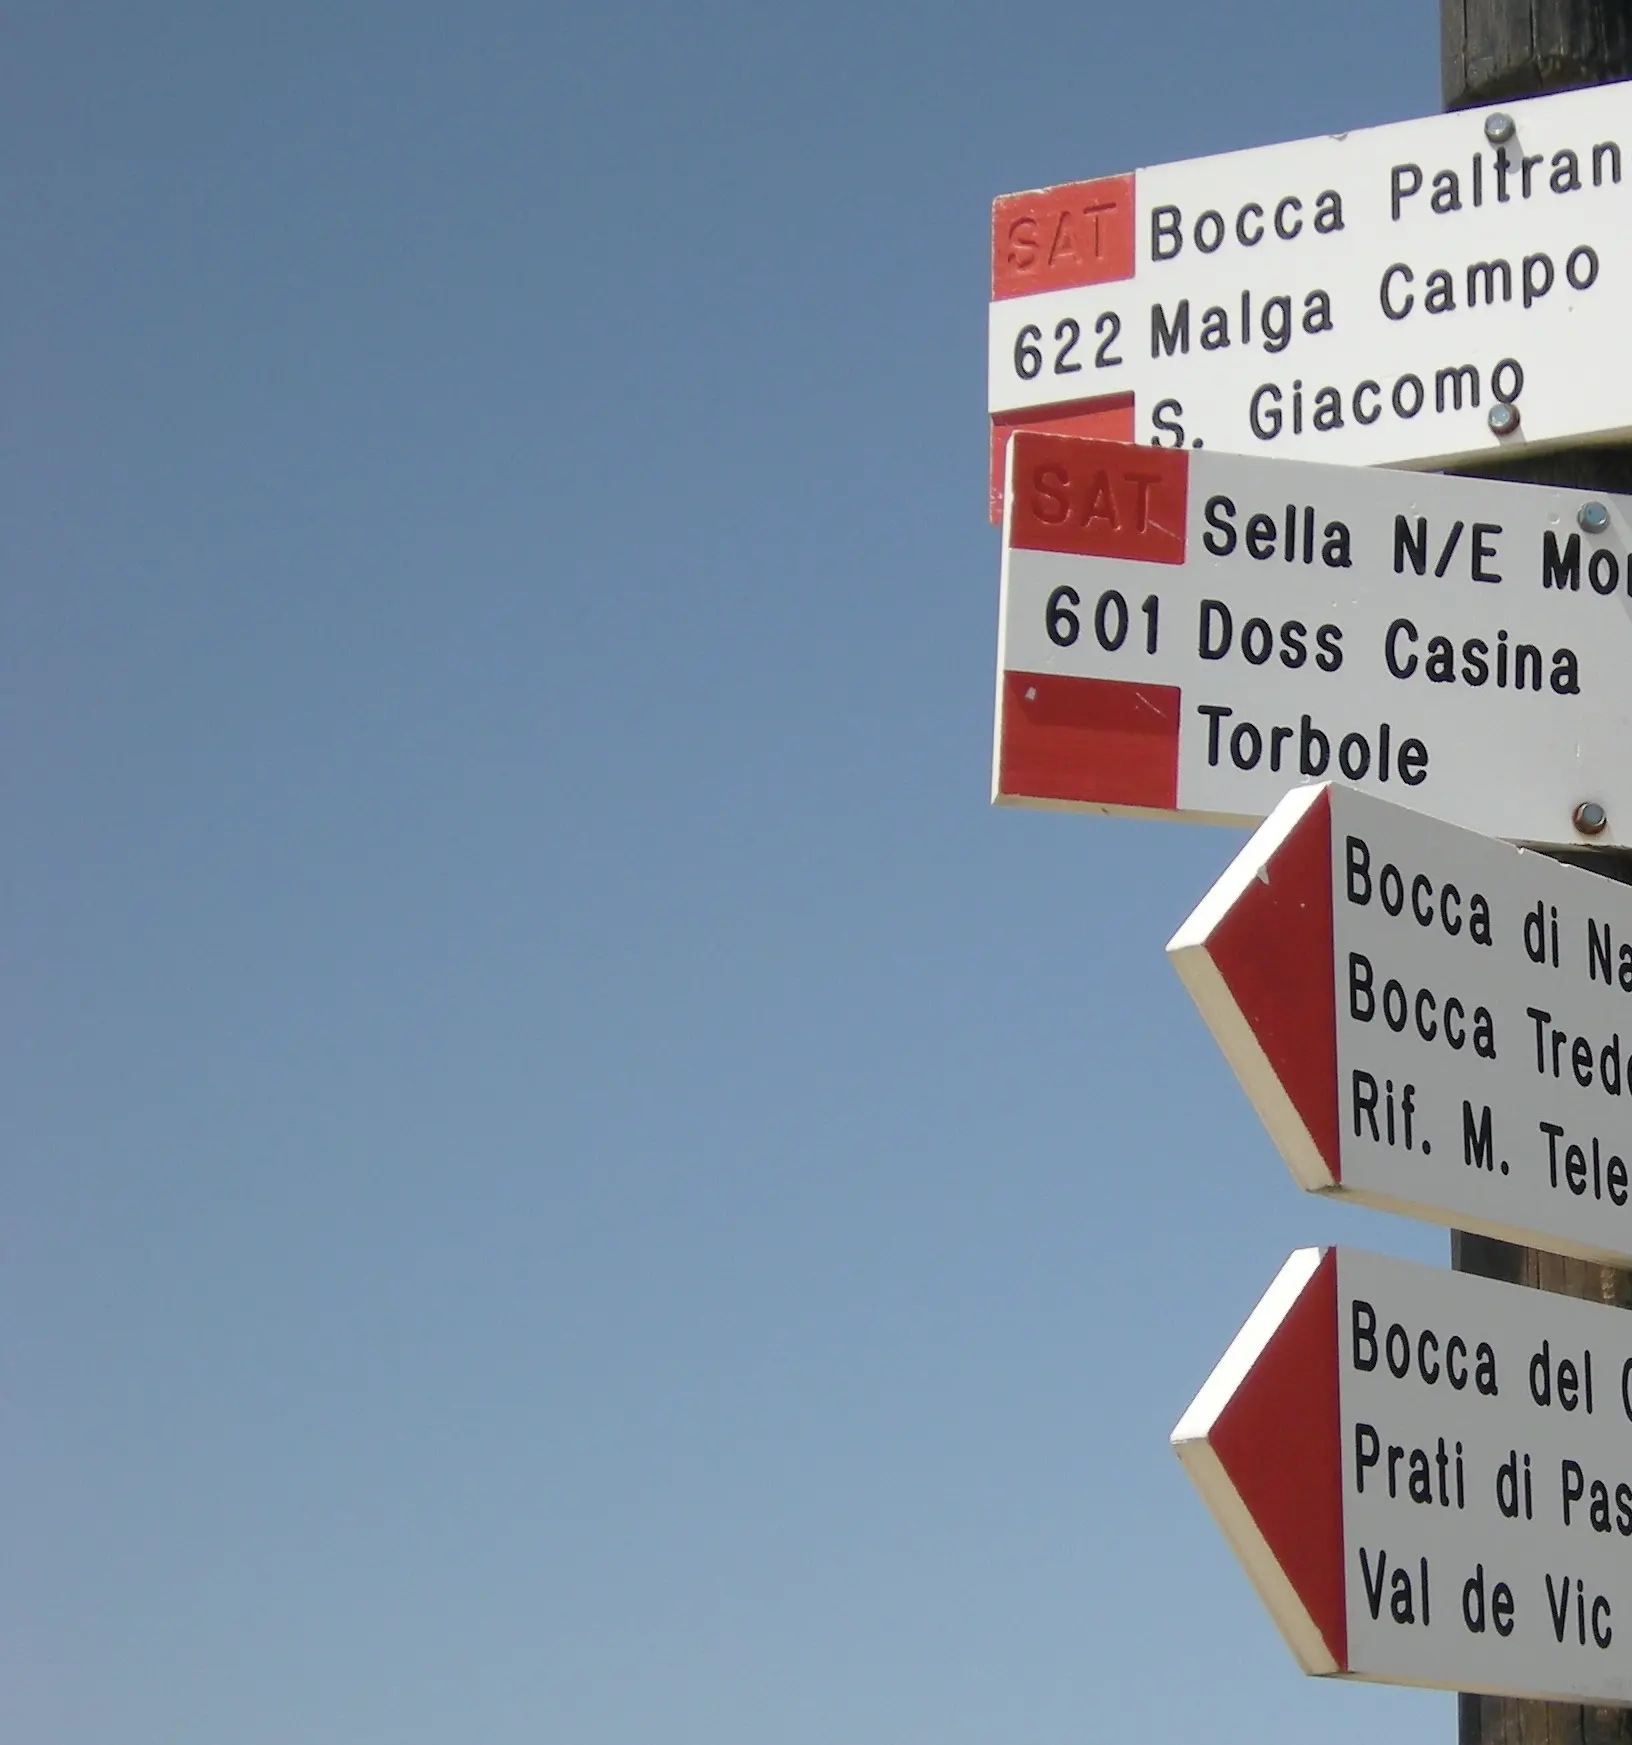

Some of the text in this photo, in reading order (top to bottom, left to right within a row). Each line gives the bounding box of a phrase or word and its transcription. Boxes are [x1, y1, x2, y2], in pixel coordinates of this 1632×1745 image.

[1007, 202, 1117, 271] SAT
[1151, 192, 1344, 262] Bocca
[1014, 312, 1122, 379] 622
[1151, 291, 1333, 358] Malga
[1380, 247, 1599, 320] Campo
[1152, 399, 1203, 448] S.
[1250, 359, 1524, 440] Giacomo
[1031, 461, 1163, 534] SAT
[1202, 495, 1353, 569] Sella
[1393, 514, 1503, 584] N/E
[1045, 585, 1159, 655] 601
[1198, 599, 1344, 673] Doss
[1384, 618, 1581, 696] Casina
[1197, 704, 1429, 787] Torbole
[1345, 834, 1494, 947] Bocca
[1523, 899, 1560, 969] di
[1348, 951, 1498, 1061] Bocca
[1351, 1068, 1432, 1156] Rif.
[1462, 1099, 1509, 1178] M.
[1351, 1298, 1499, 1397] Bocca
[1528, 1338, 1594, 1415] del
[1354, 1422, 1466, 1510] Prati
[1495, 1449, 1534, 1521] di
[1358, 1546, 1431, 1627] Val
[1461, 1562, 1516, 1638] de
[1544, 1572, 1613, 1650] Vic
